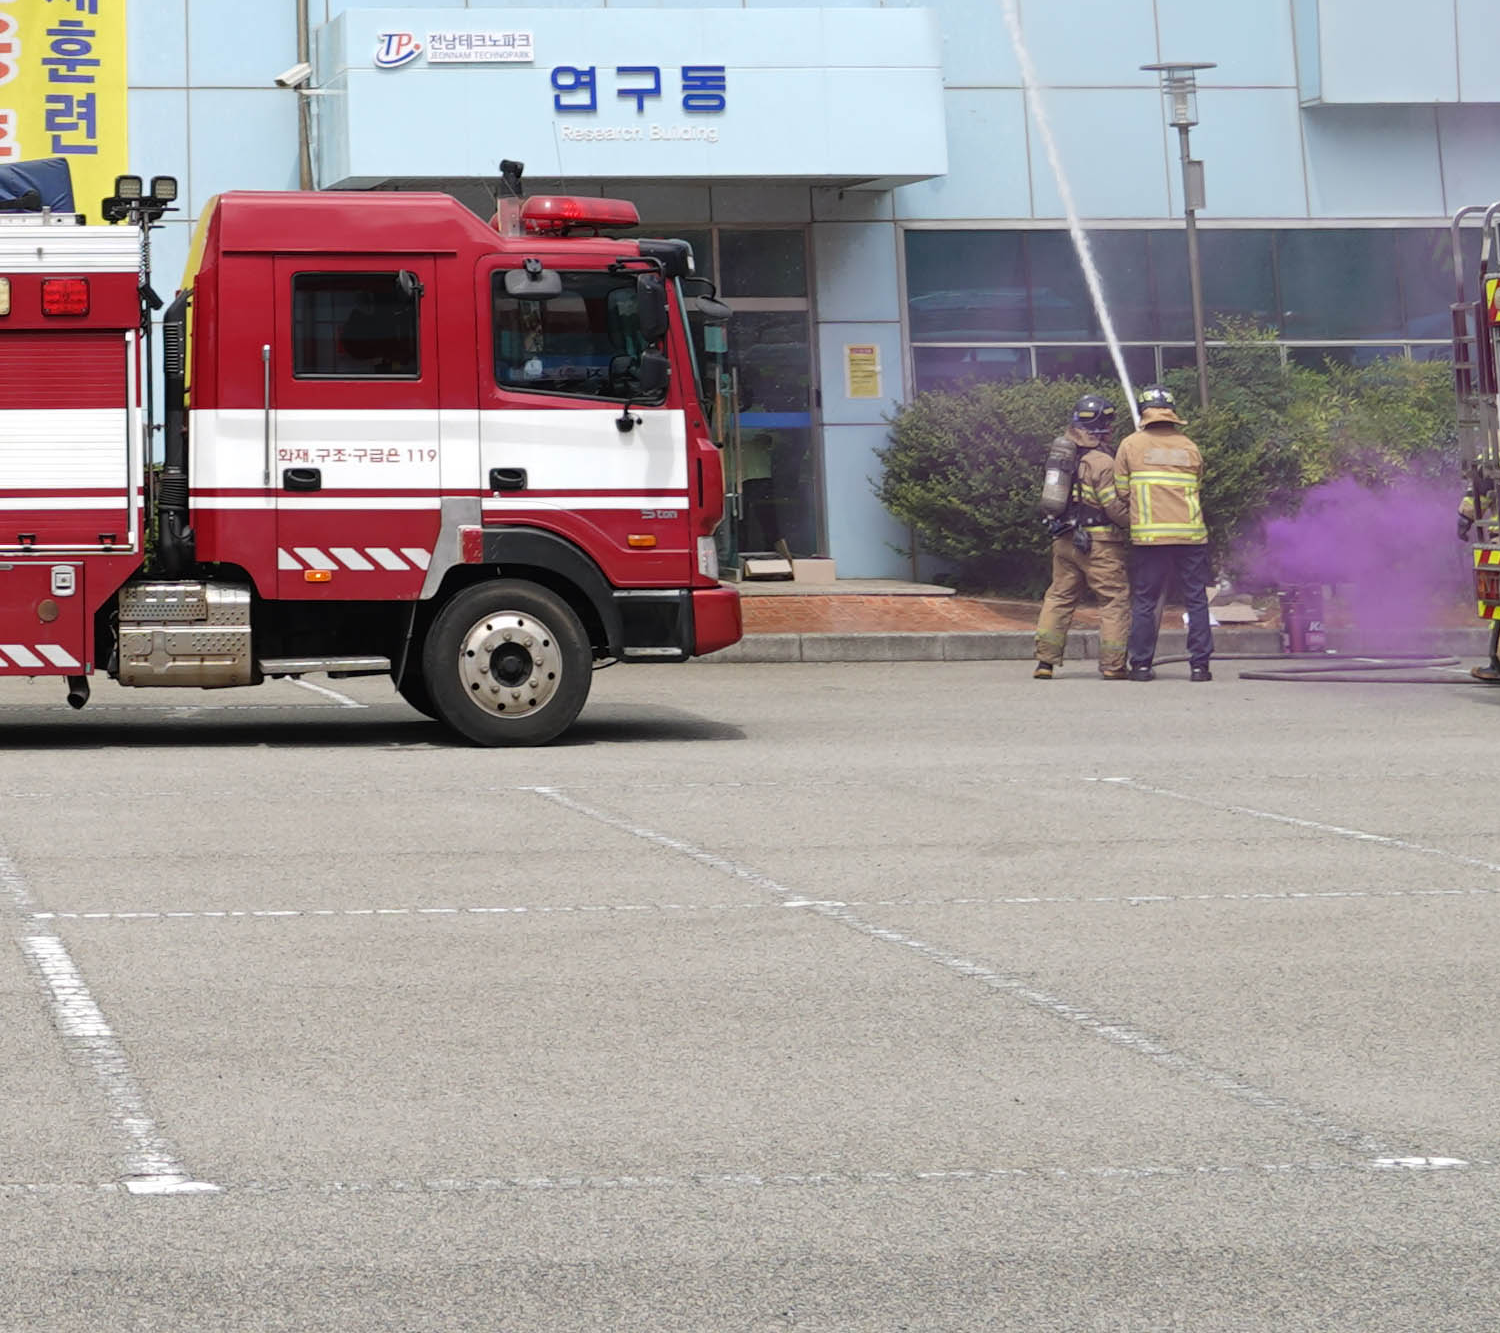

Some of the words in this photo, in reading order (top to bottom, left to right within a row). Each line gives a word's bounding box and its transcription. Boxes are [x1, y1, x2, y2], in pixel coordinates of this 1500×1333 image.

[429, 34, 532, 50] 전남테크노파크
[430, 51, 472, 60] JEONNAM
[474, 51, 530, 60] TECHNOPARK
[550, 65, 727, 113] 연구동
[561, 124, 643, 142] Research
[650, 123, 720, 144] Building
[407, 448, 437, 463] 119
